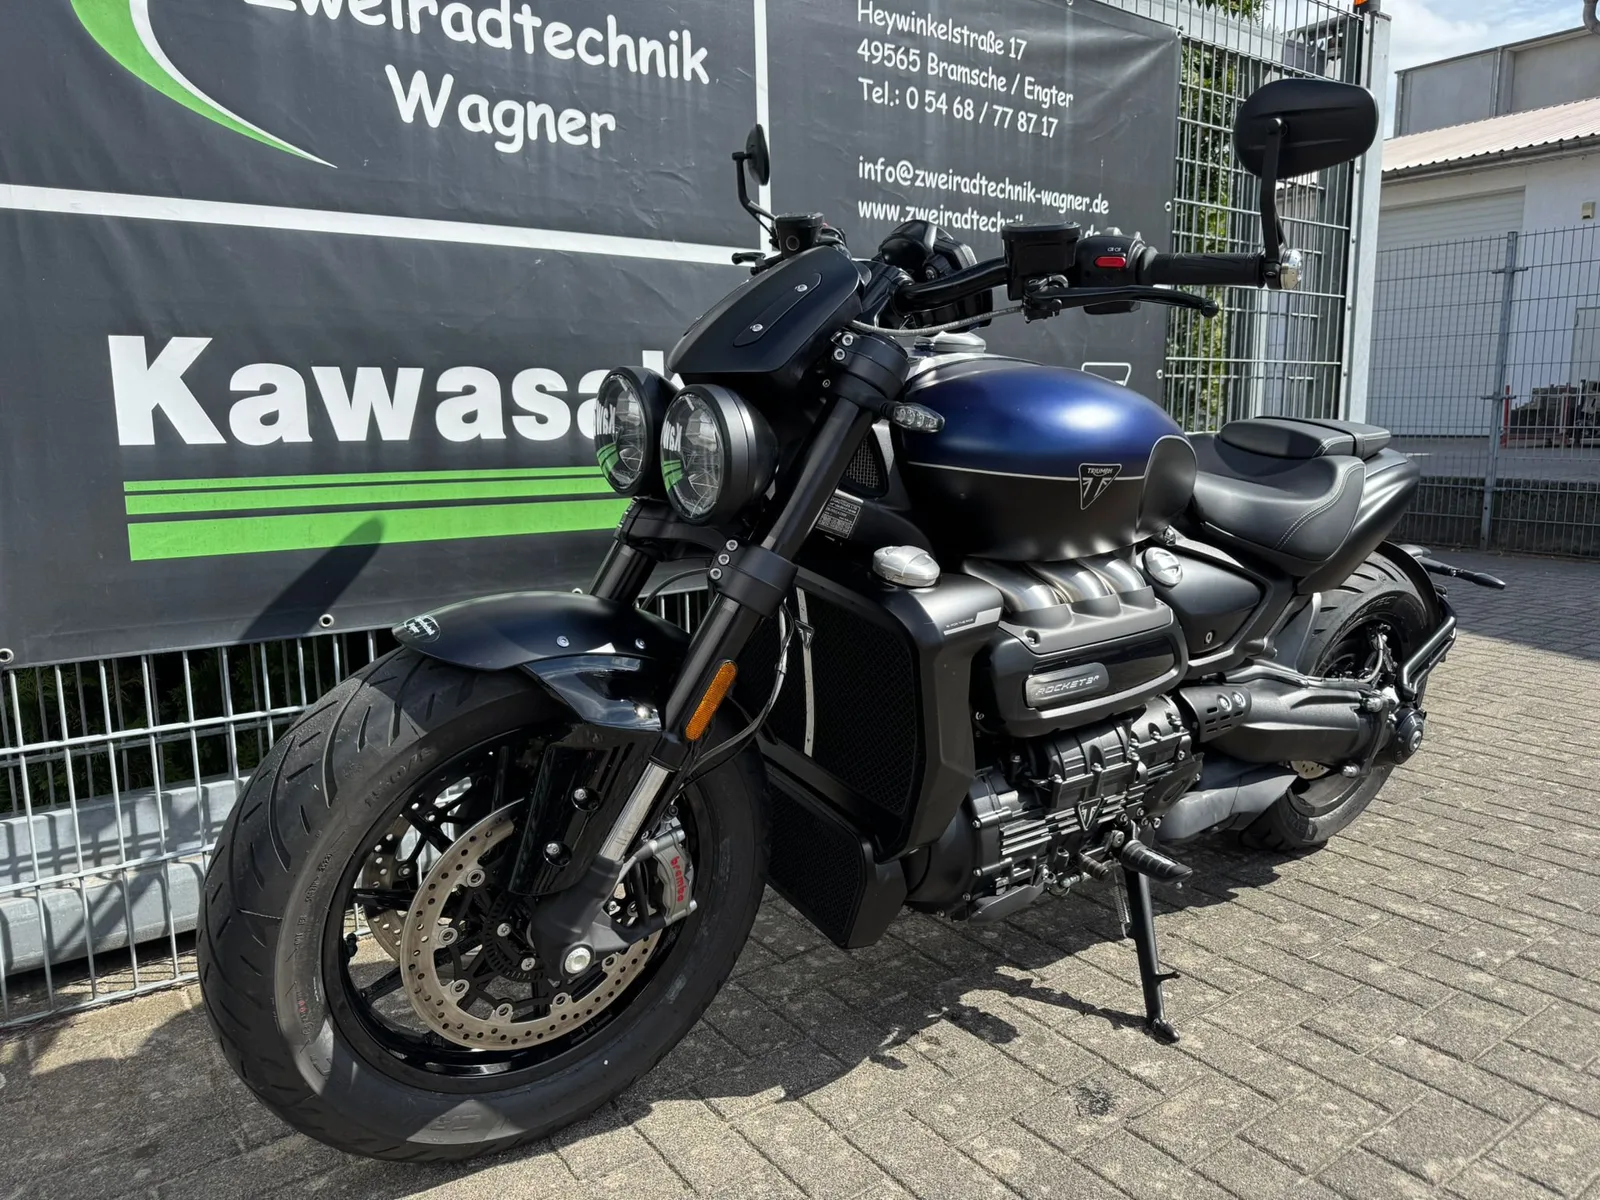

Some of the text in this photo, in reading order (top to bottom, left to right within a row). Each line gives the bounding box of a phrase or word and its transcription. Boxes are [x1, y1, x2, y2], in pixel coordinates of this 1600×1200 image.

[243, 0, 710, 85] weiradtechnik
[857, 0, 1028, 60] Heywinkelstraße 17
[857, 38, 1074, 109] 49565 Bramsche / Engter
[858, 76, 900, 107] Tel.:
[905, 86, 919, 110] 0
[924, 89, 949, 116] 54
[952, 95, 975, 121] 68
[992, 104, 1014, 129] 77
[384, 63, 617, 154] Wagner
[858, 155, 1110, 215] info@zweiradtechnik-wagner.de
[108, 335, 684, 446] Kawas
[1087, 467, 1114, 477] TRIUMPH
[669, 855, 687, 903] brembo
